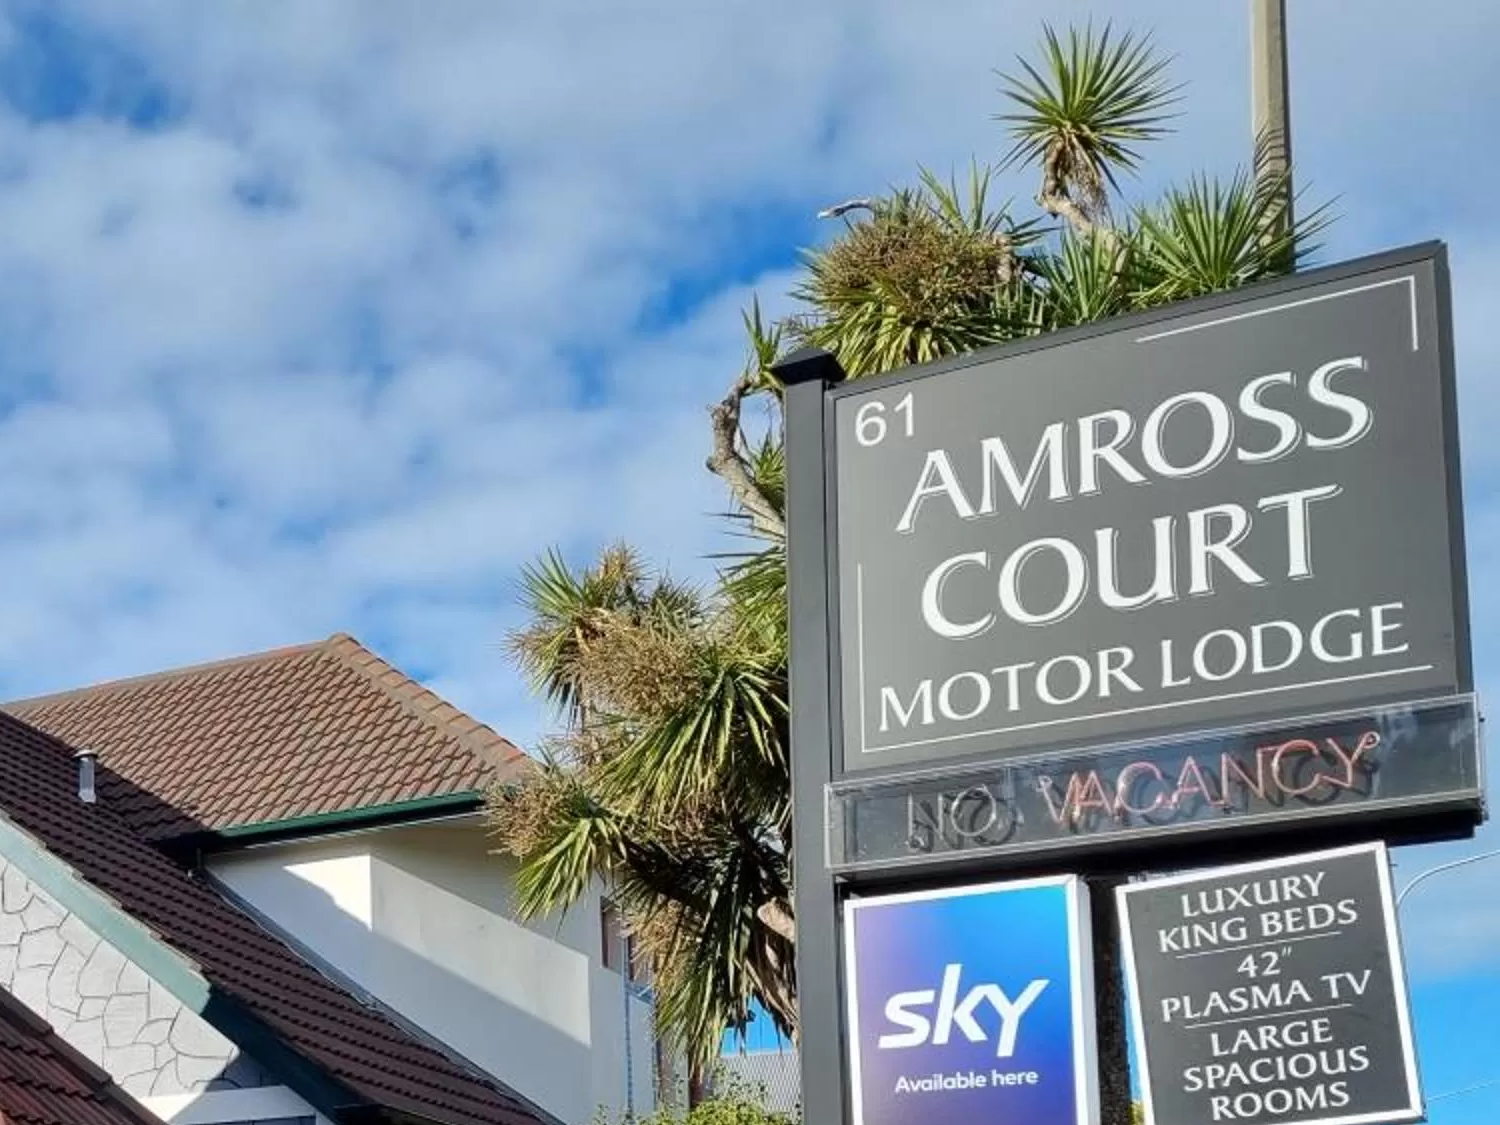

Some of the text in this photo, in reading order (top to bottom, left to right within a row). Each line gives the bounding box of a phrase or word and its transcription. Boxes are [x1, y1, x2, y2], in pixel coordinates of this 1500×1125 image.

[854, 393, 915, 446] 61
[895, 355, 1373, 533] AMROSS
[921, 484, 1343, 641] COURT
[878, 602, 1409, 732] MOTOR LODGE
[904, 731, 1381, 848] NO VACANCY
[1181, 871, 1325, 918] LUXURY
[1158, 899, 1358, 953] KING BEDS
[1237, 946, 1293, 977] 42"
[877, 963, 1050, 1057] sky
[1160, 969, 1373, 1023] PLASMA TV
[1210, 1017, 1334, 1057] LARGE
[894, 1067, 1039, 1094] Available here
[1182, 1046, 1370, 1092] SPACIOUS
[1211, 1080, 1350, 1121] ROOMS
